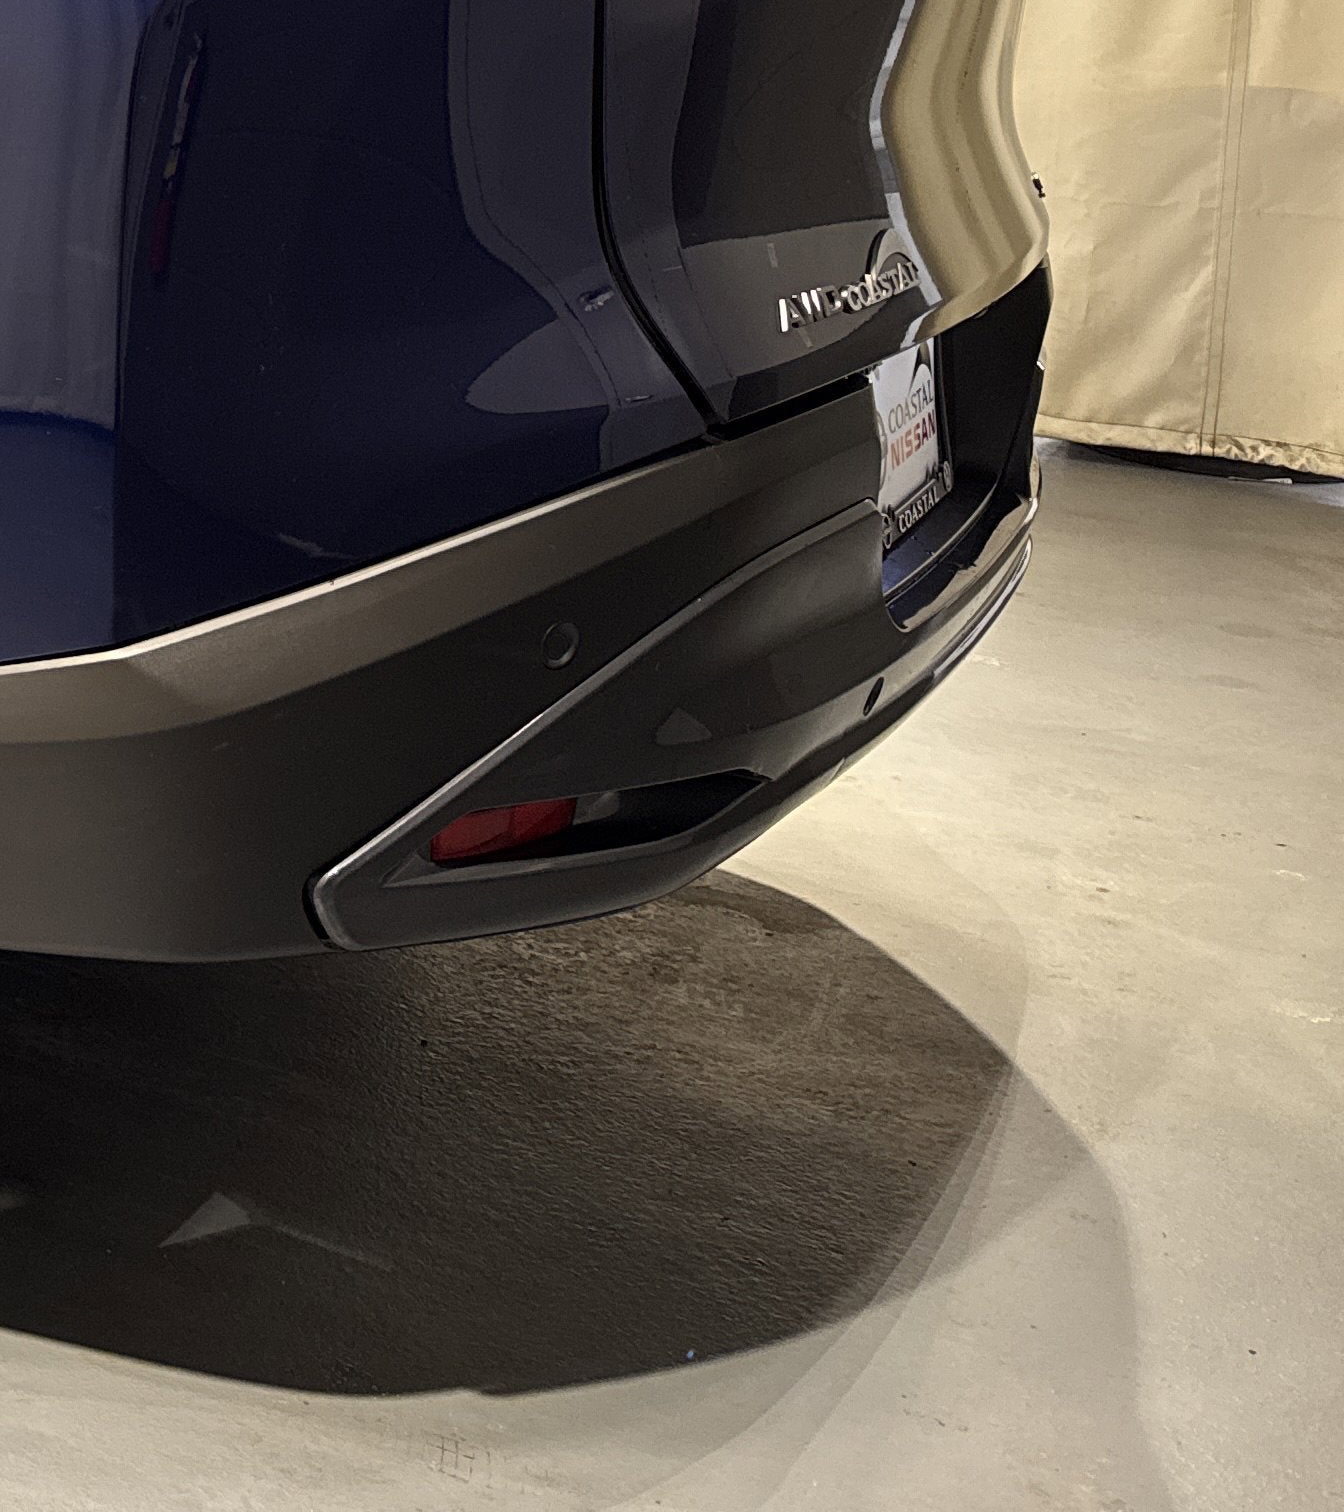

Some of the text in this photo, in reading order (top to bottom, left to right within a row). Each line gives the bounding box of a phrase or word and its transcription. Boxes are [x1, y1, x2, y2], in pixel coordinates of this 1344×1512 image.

[888, 379, 934, 434] COASTAL
[890, 408, 937, 470] NISSAN
[898, 484, 940, 534] COASTAL
